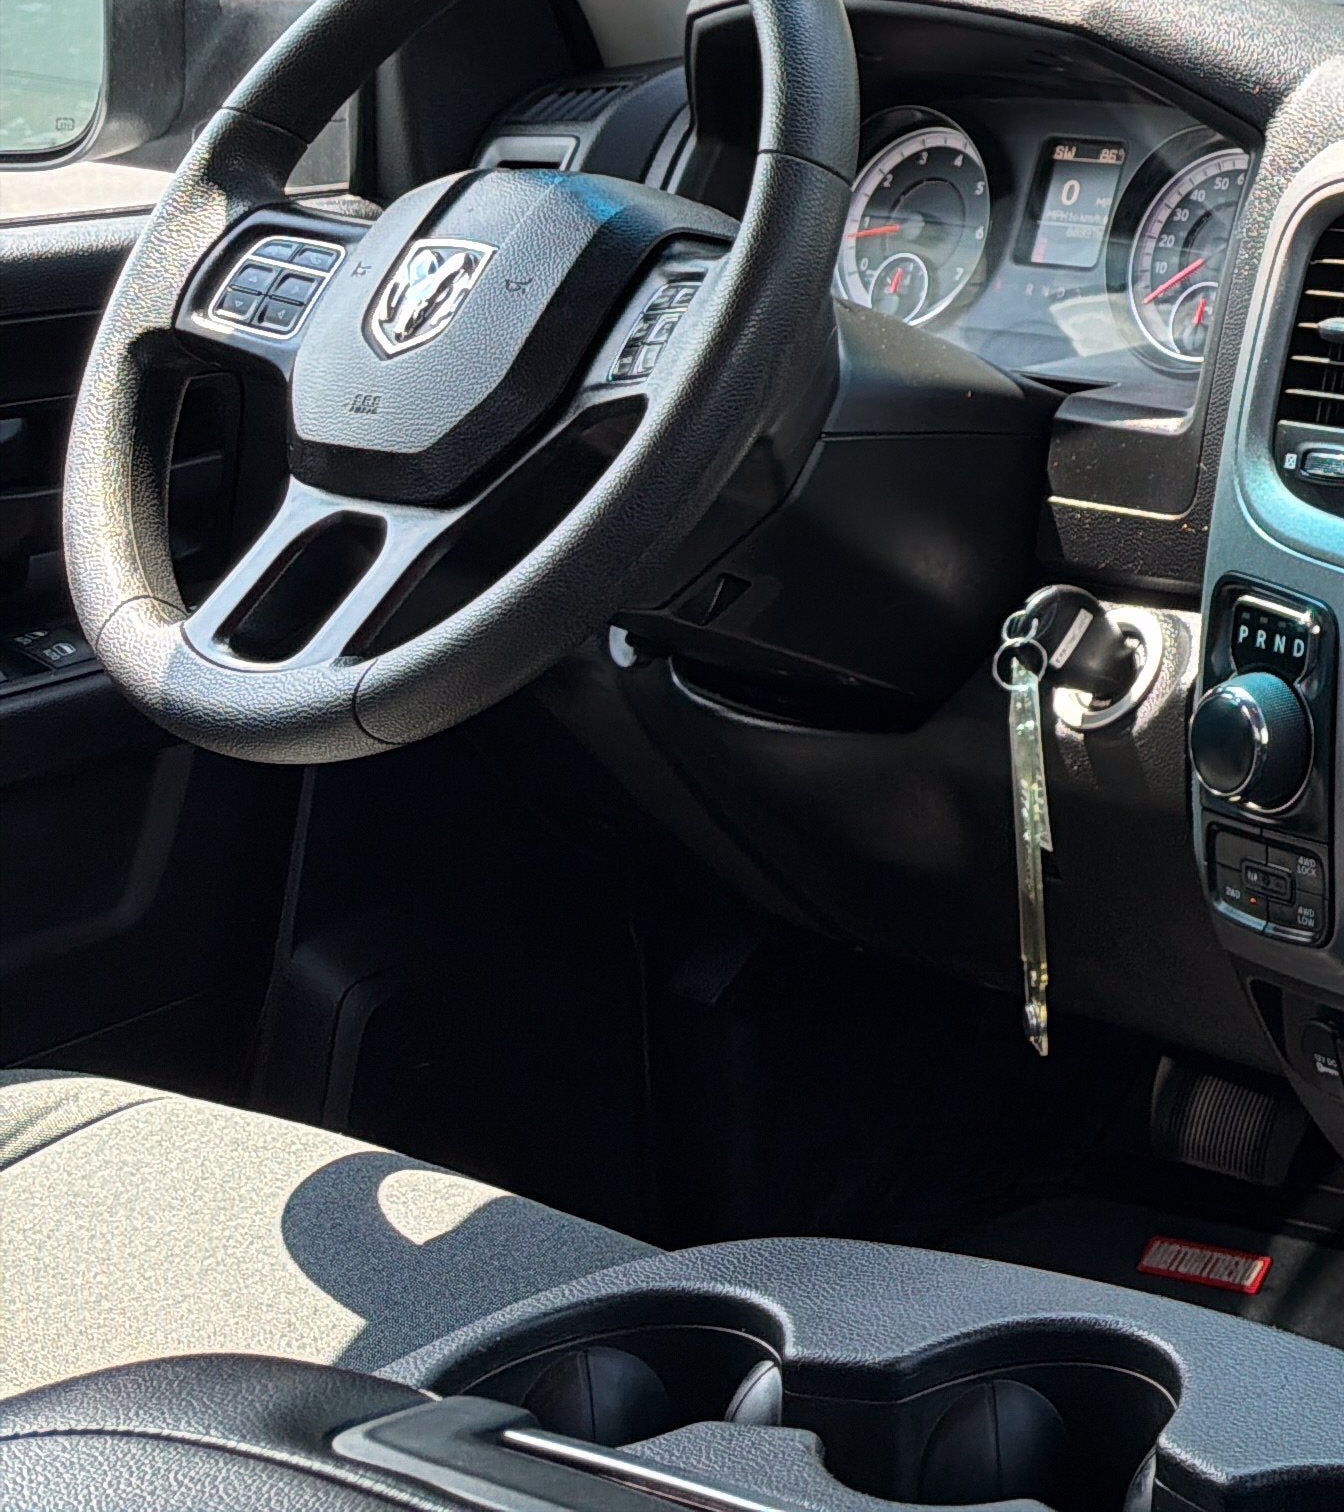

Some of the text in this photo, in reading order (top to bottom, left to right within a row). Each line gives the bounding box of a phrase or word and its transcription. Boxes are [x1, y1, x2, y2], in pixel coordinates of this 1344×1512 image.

[918, 152, 928, 165] 3
[1053, 145, 1076, 160] SW
[953, 154, 964, 167] 4
[883, 174, 893, 187] 2
[1213, 177, 1229, 190] 50
[974, 181, 985, 195] 5
[1062, 179, 1080, 206] 0
[1190, 189, 1206, 202] 40
[1173, 208, 1189, 221] 30
[864, 216, 870, 227] 1
[975, 226, 984, 239] 6
[1159, 235, 1175, 248] 20
[860, 257, 868, 270] 0
[1155, 261, 1168, 273] 10
[956, 268, 964, 280] 7
[1238, 624, 1305, 658] P R N D
[1297, 855, 1316, 868] 4WD
[1297, 864, 1317, 878] LOCK
[1297, 905, 1315, 918] 4WD
[1297, 915, 1315, 928] LOW
